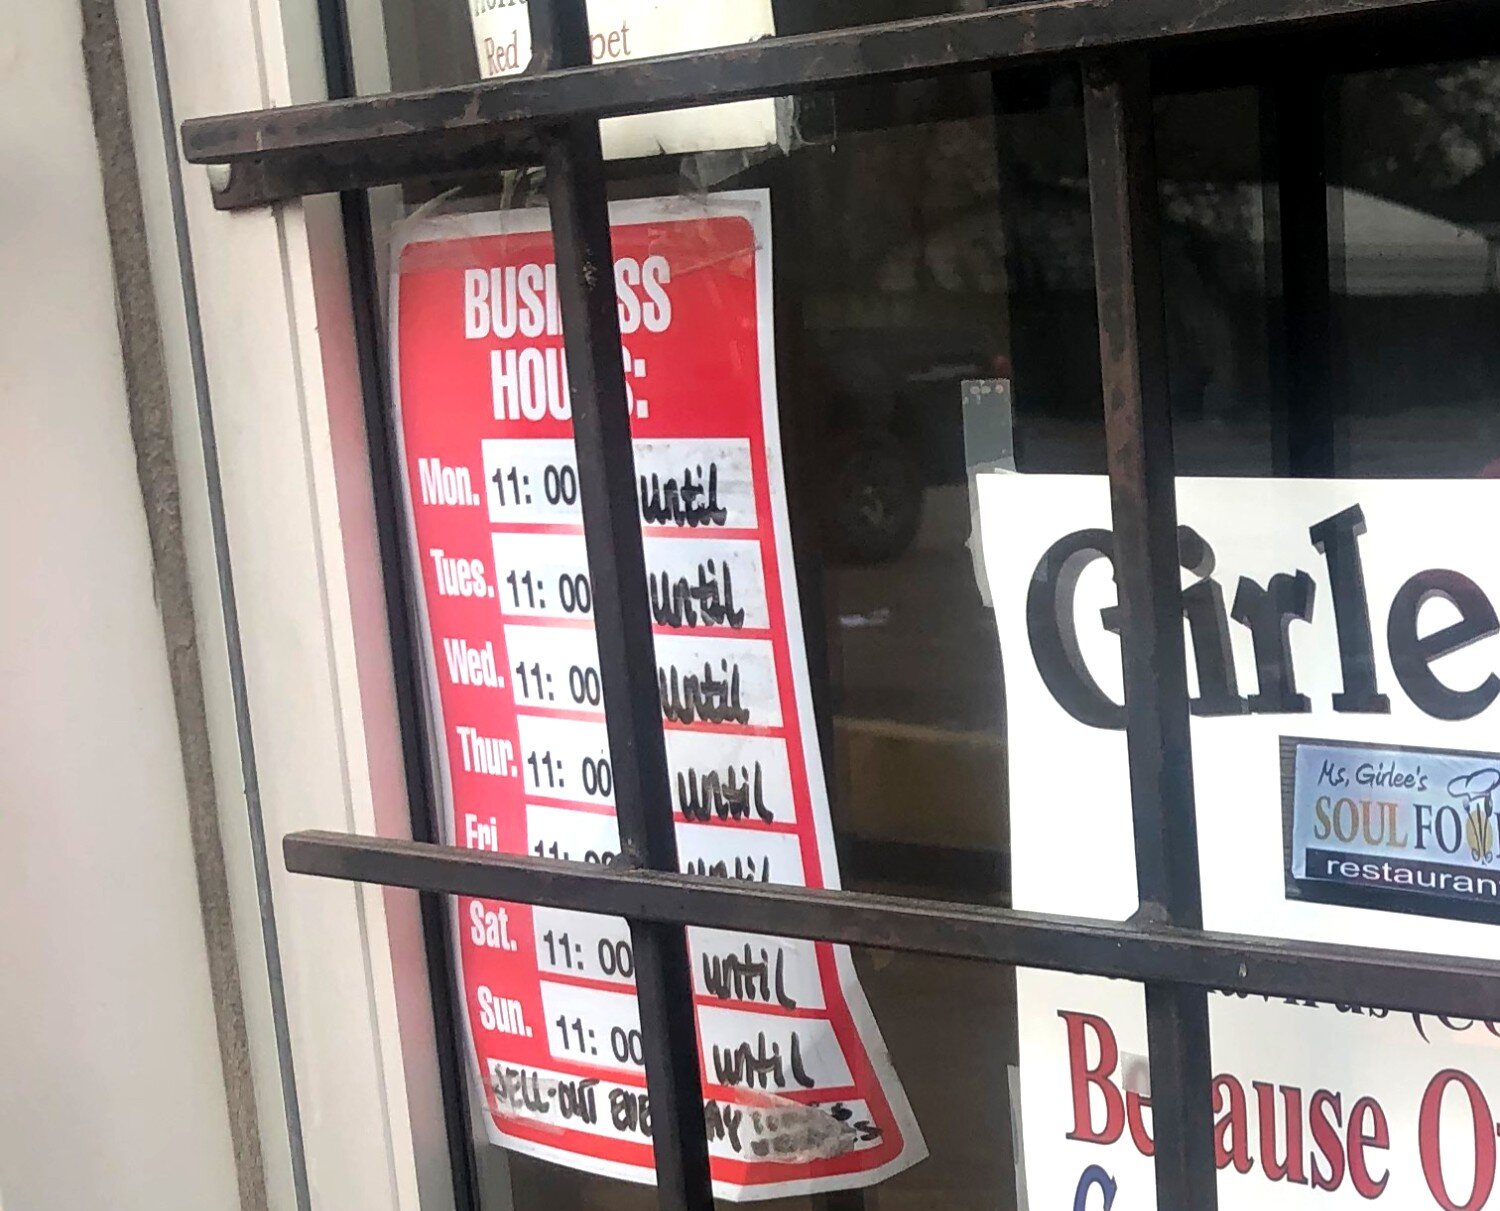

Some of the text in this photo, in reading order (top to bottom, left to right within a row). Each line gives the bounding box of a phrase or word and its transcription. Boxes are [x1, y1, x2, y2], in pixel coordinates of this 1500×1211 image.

[484, 30, 520, 76] Red
[465, 255, 672, 339] BUSISS
[418, 457, 480, 506] Mon.
[641, 462, 727, 527] until
[430, 549, 495, 599] Tues.
[650, 559, 745, 628] until
[443, 638, 505, 689] Wed.
[660, 659, 750, 725] until
[455, 725, 518, 778] Thur.
[677, 760, 775, 824] until
[1355, 762, 1428, 792] Girlee's
[1314, 796, 1408, 849] SOUL
[469, 900, 518, 951] Sat.
[702, 942, 796, 1009] until
[477, 985, 533, 1037] Sun.
[713, 1030, 815, 1089] until
[1057, 1009, 1390, 1200] Beause
